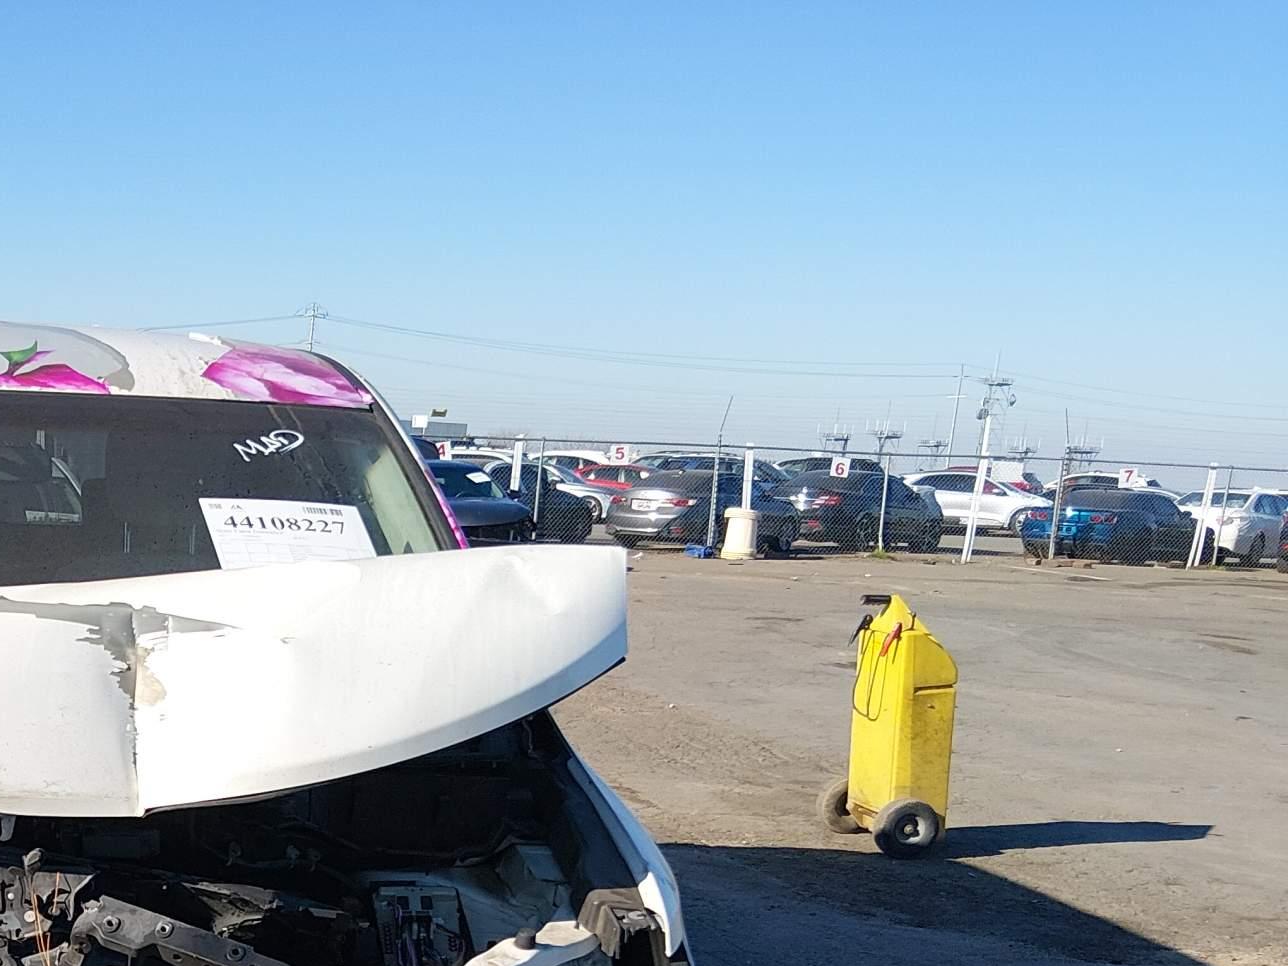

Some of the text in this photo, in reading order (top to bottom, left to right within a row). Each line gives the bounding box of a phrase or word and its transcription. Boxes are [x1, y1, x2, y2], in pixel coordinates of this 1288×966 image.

[232, 429, 305, 463] MAD
[437, 443, 446, 457] 4
[615, 447, 625, 460] 5
[835, 462, 846, 476] 6
[1124, 469, 1134, 483] 7
[223, 513, 345, 536] 44108227
